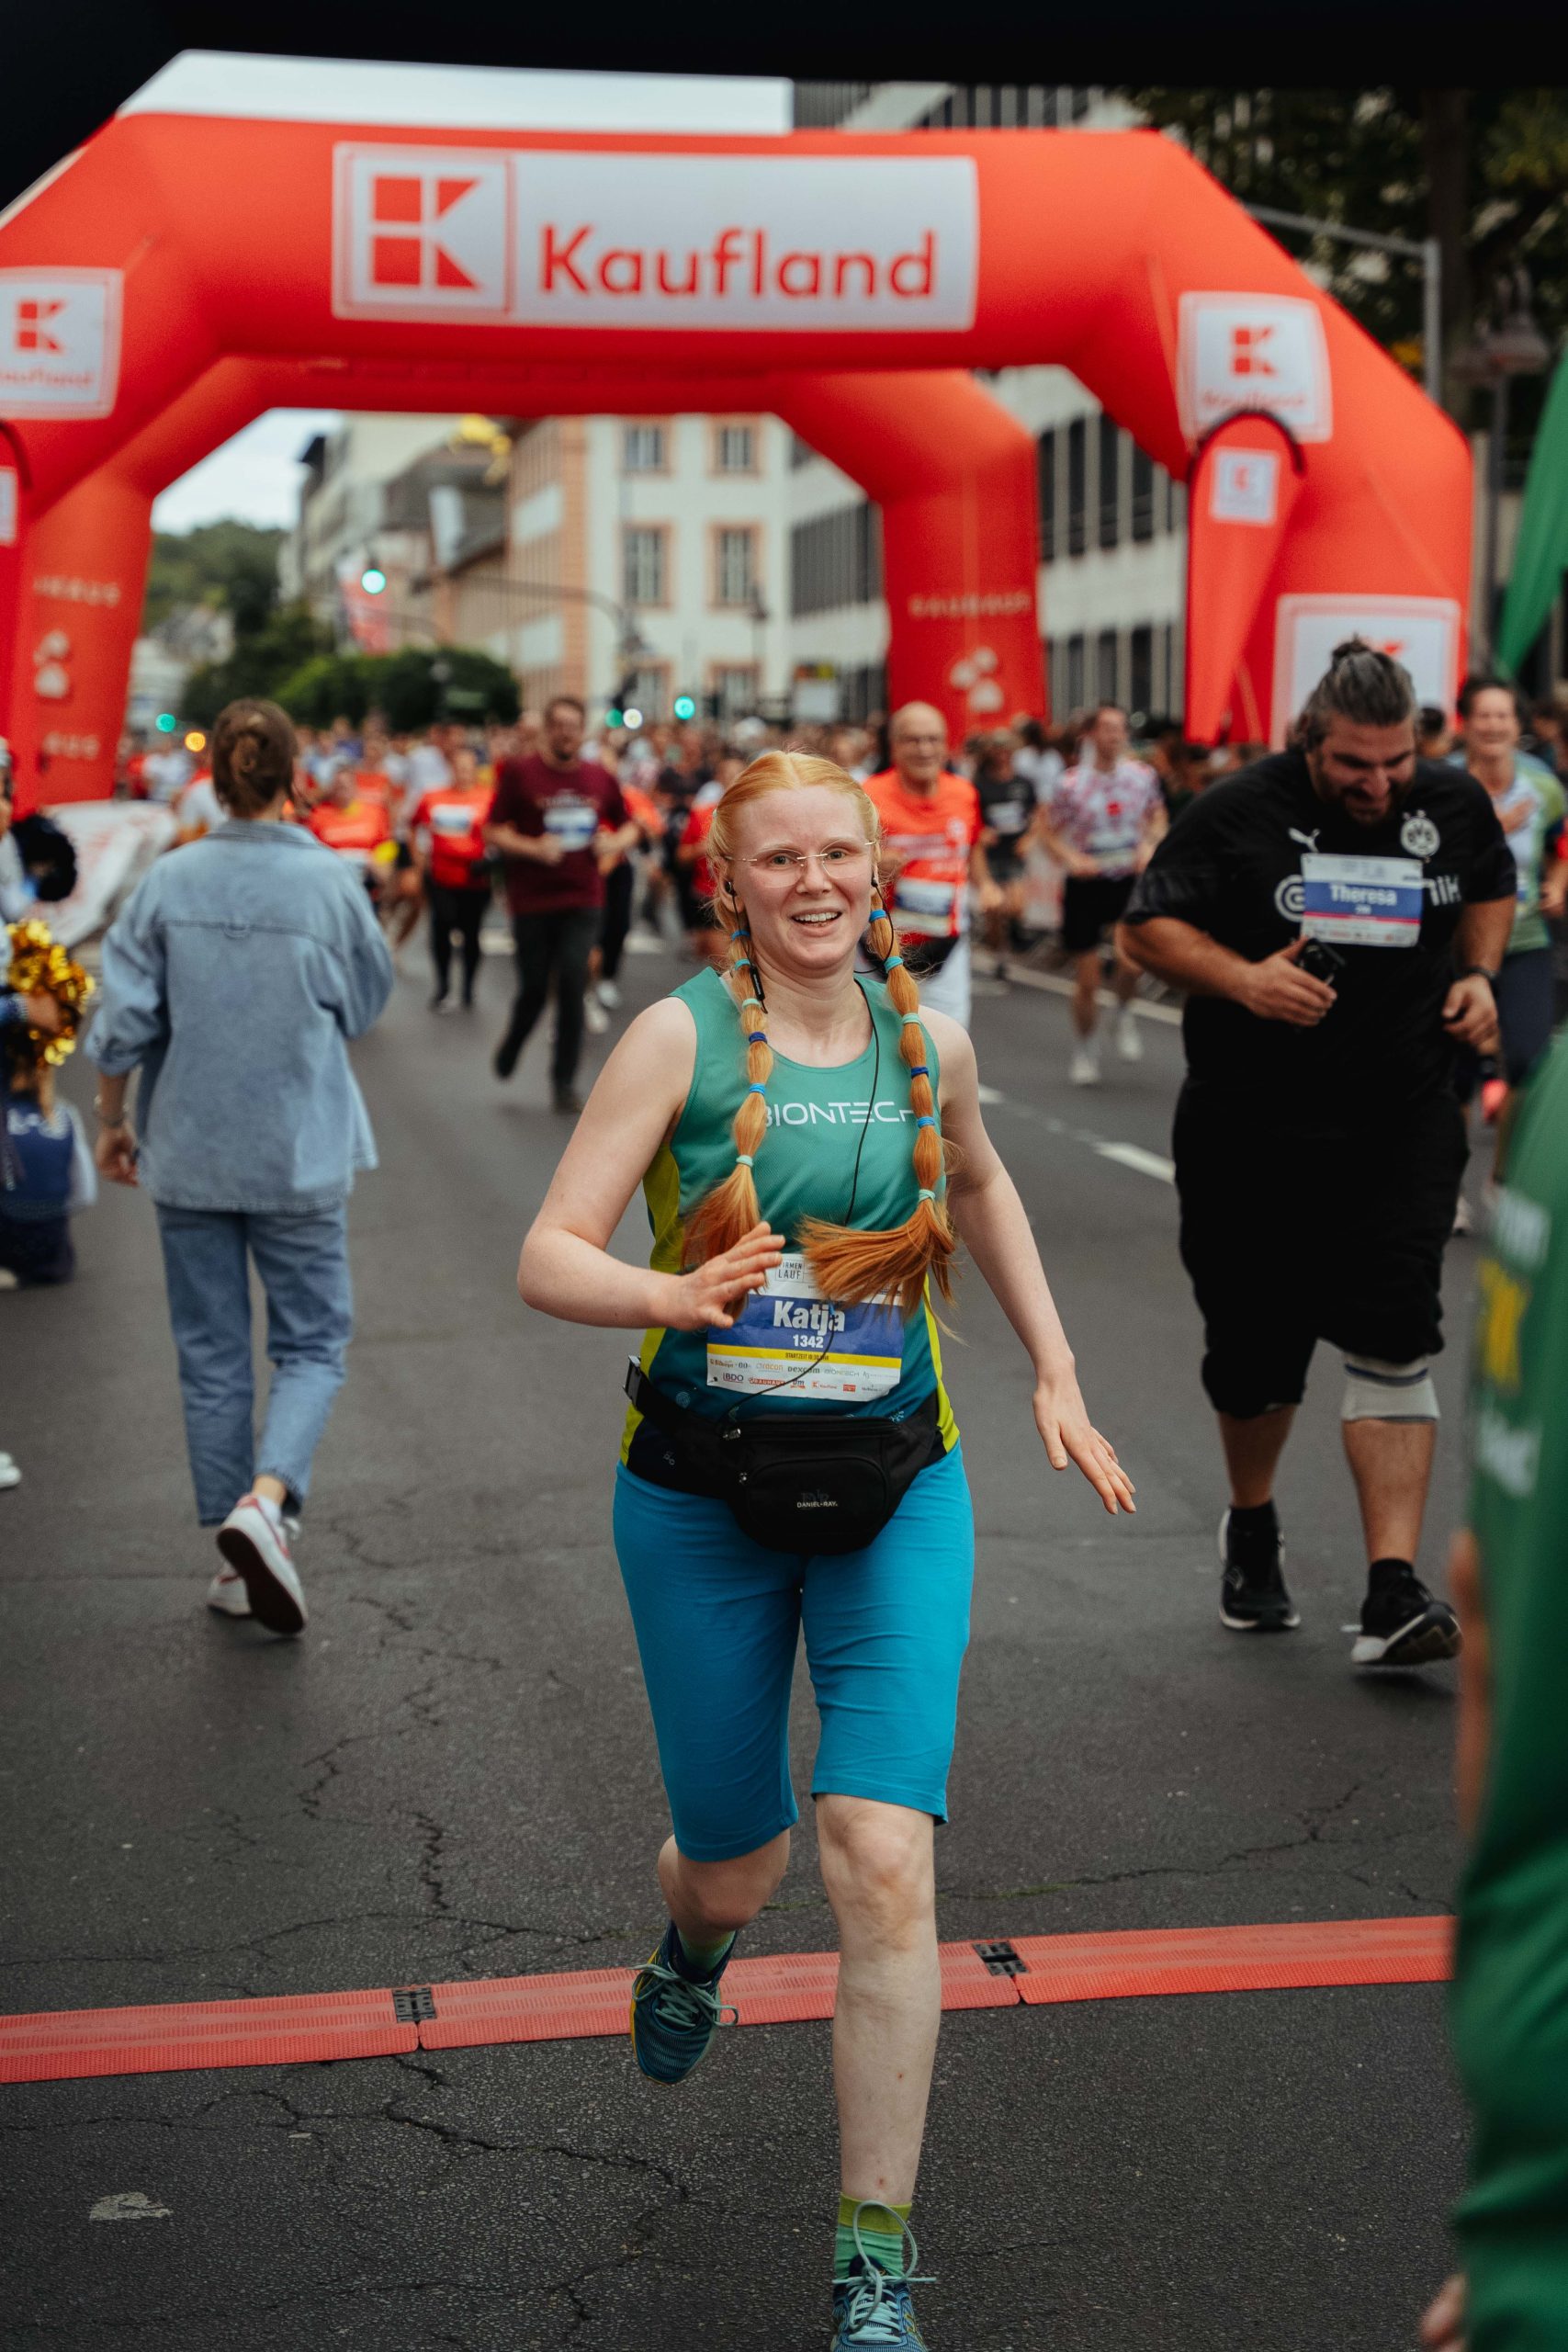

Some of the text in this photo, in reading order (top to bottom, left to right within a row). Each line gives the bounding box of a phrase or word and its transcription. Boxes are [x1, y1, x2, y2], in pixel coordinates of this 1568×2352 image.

[540, 221, 935, 300] Kaufland
[1329, 882, 1397, 907] Theresa
[778, 1269, 802, 1280] LAUF
[779, 1261, 803, 1270] IRMEN
[773, 1300, 845, 1336] Katja
[793, 1334, 824, 1349] 1342
